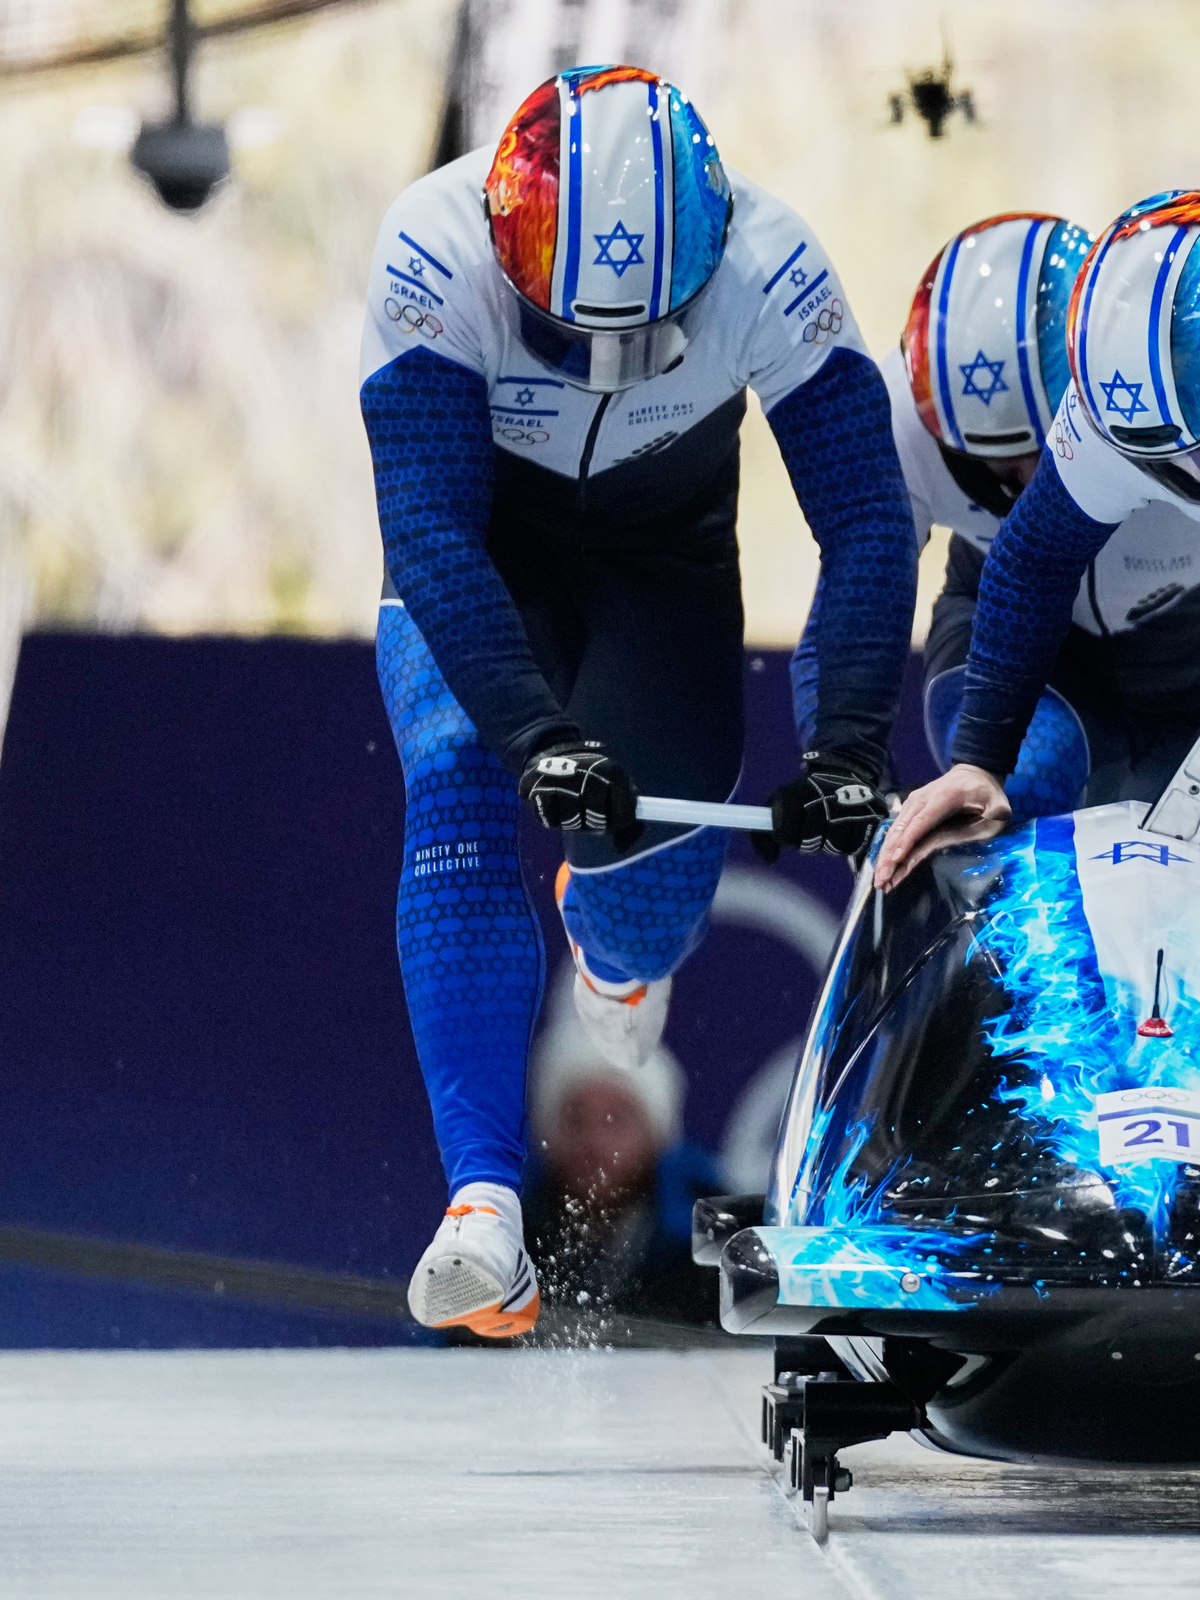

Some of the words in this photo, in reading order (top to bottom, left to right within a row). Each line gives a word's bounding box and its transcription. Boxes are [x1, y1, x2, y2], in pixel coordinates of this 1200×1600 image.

[390, 281, 434, 311] ISRAEL
[797, 286, 832, 320] ISRAEL
[415, 844, 450, 862] NINETY
[457, 841, 478, 854] ONE
[414, 856, 480, 877] COLLECTIVE
[1123, 1119, 1190, 1148] 21
